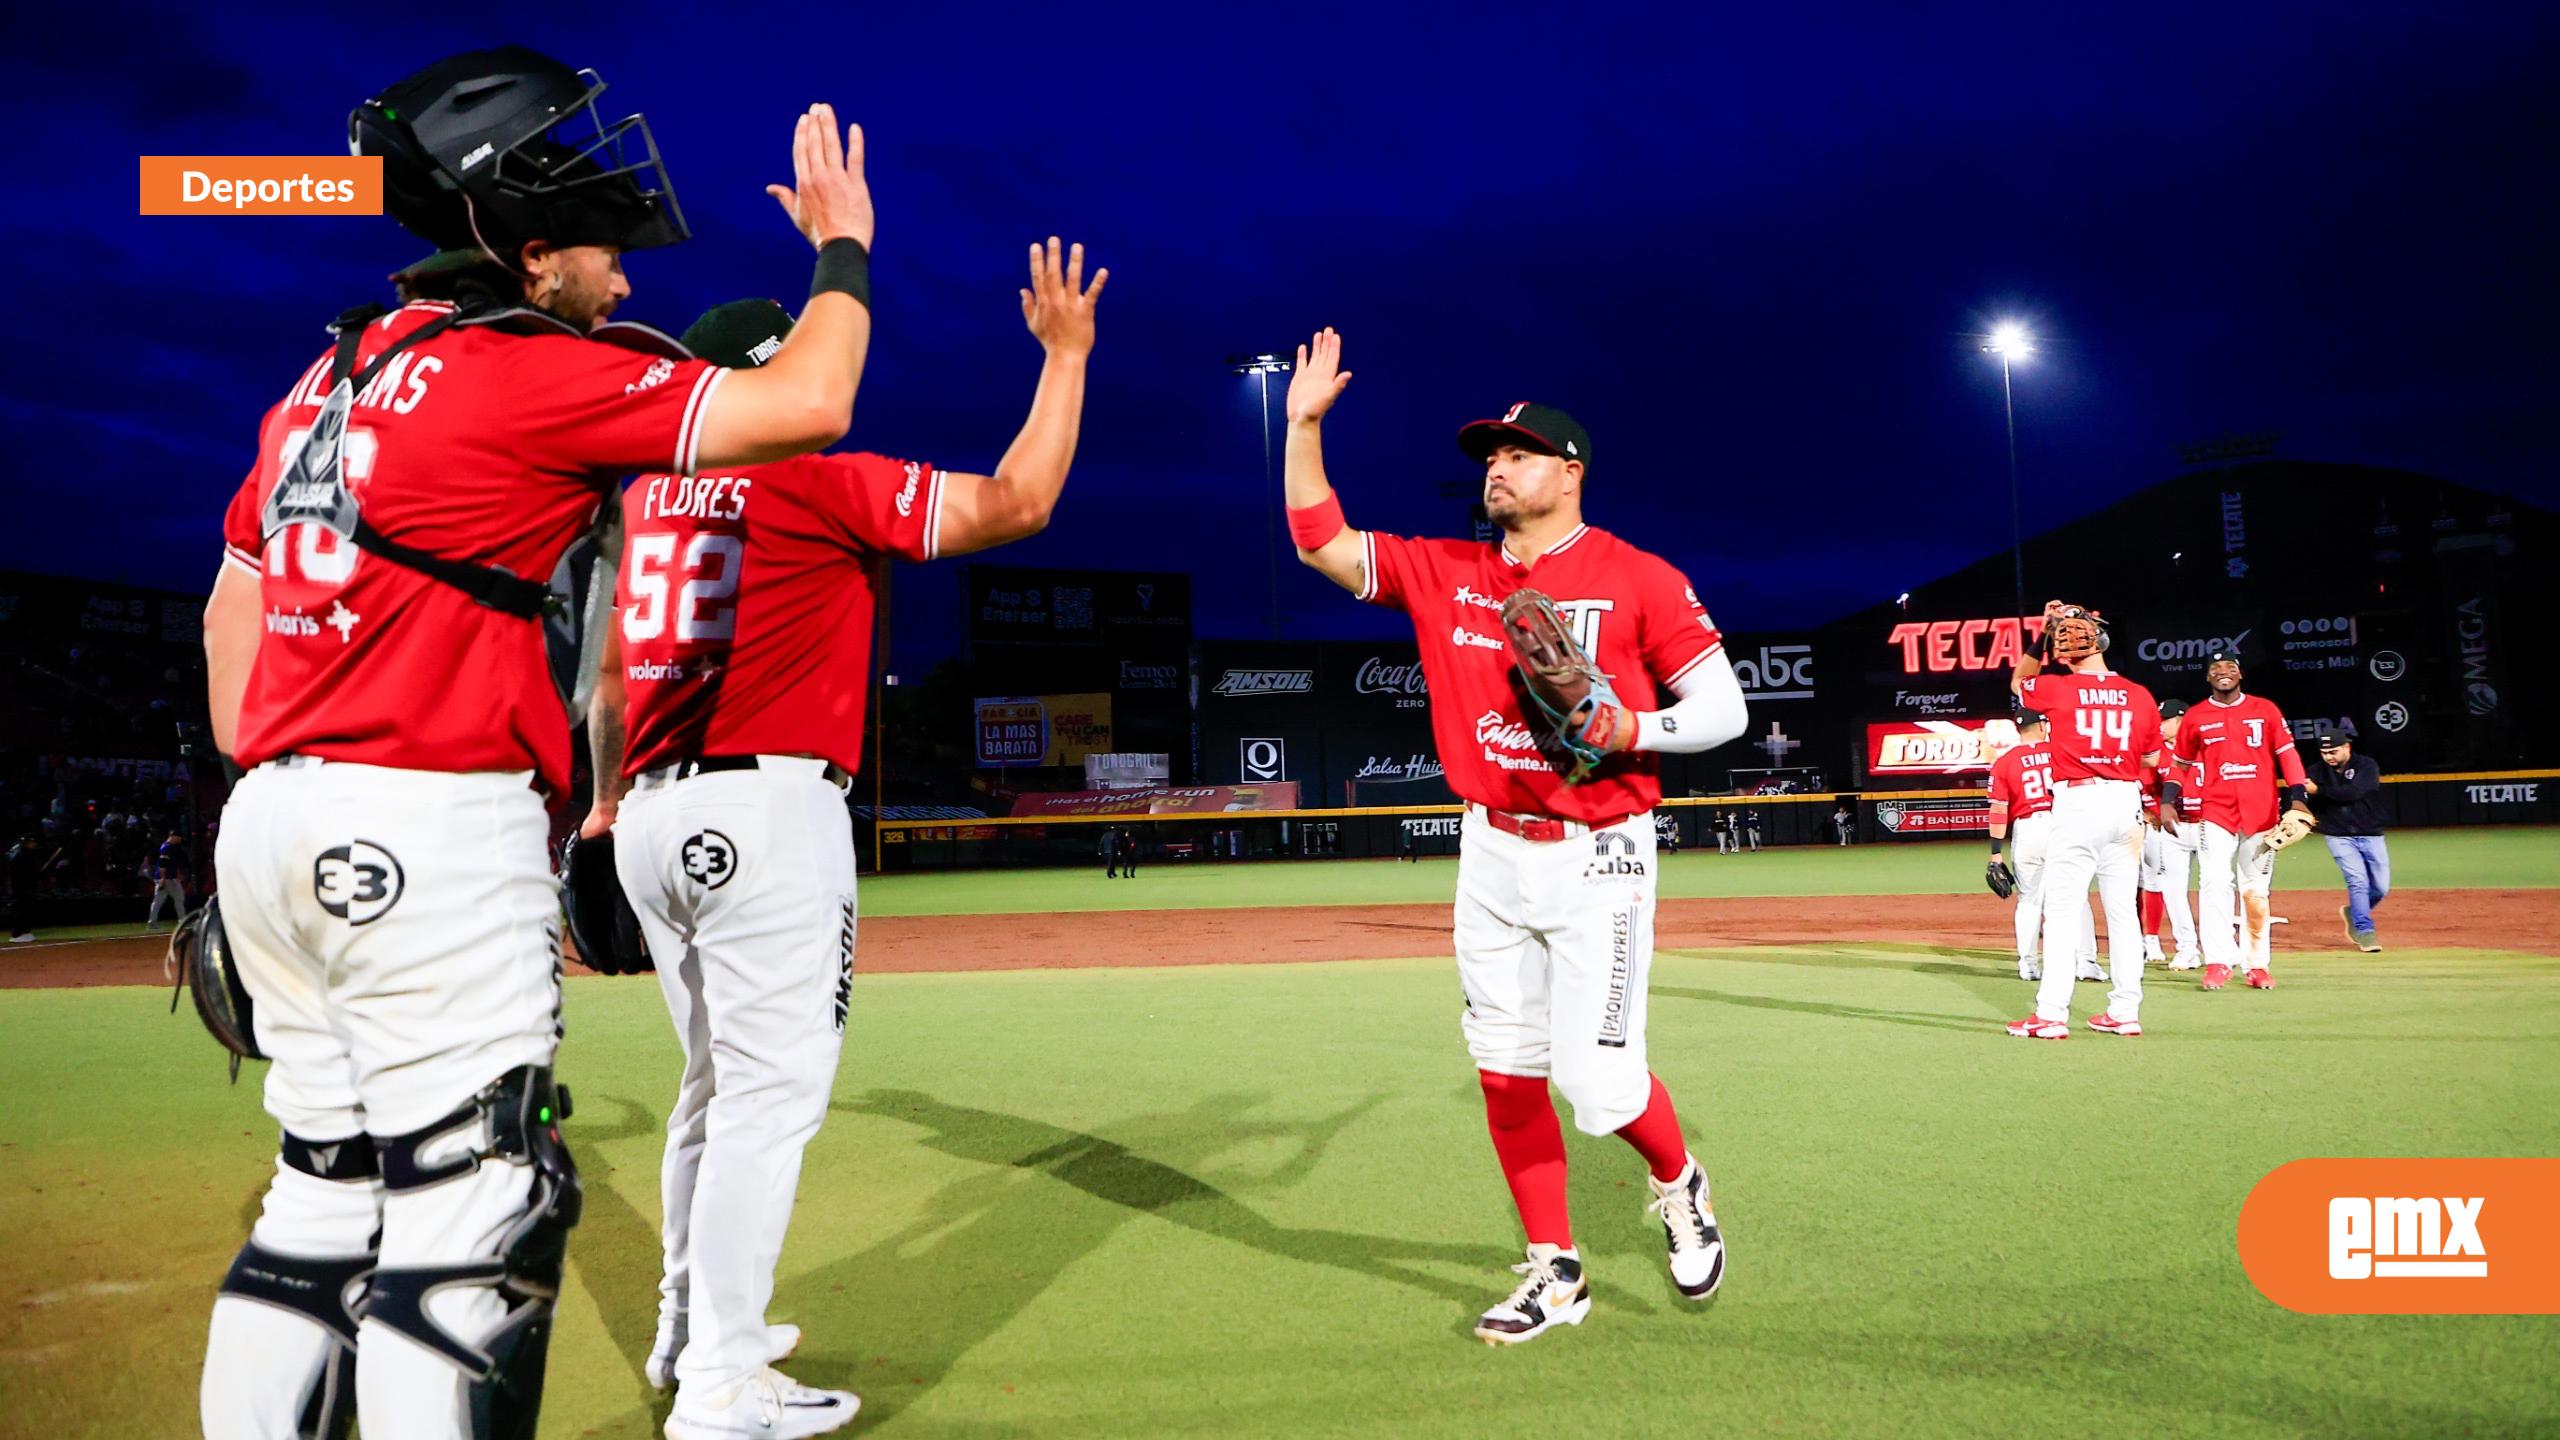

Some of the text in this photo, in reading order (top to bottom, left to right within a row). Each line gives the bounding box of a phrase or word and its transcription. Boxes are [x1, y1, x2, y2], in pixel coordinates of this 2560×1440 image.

[644, 476, 751, 520] FLORES
[622, 531, 744, 643] 52
[1888, 615, 2050, 673] TECAT
[2137, 628, 2251, 661] Comex
[628, 658, 683, 680] volaris
[1732, 645, 1814, 690] abc
[2161, 662, 2203, 673] Vive tus
[1214, 671, 1314, 694] AMSOIL
[1396, 700, 1425, 708] ZERO
[1895, 690, 1960, 707] Forever
[2078, 688, 2128, 706] RAMOS
[2380, 709, 2404, 724] 33
[985, 724, 1036, 739] LA MAS
[2075, 709, 2133, 752] 44
[985, 741, 1037, 755] BARATA
[1893, 738, 1981, 762] TOROS
[1355, 756, 1402, 777] Salsa
[2080, 756, 2111, 765] volaris
[1100, 788, 1169, 803] home
[1173, 788, 1216, 798] run
[2465, 783, 2541, 803] TECATE
[1928, 814, 1989, 825] BANORTE
[833, 898, 855, 1034] AMSOIL
[1603, 911, 1628, 1032] PAQUETEXPRESS
